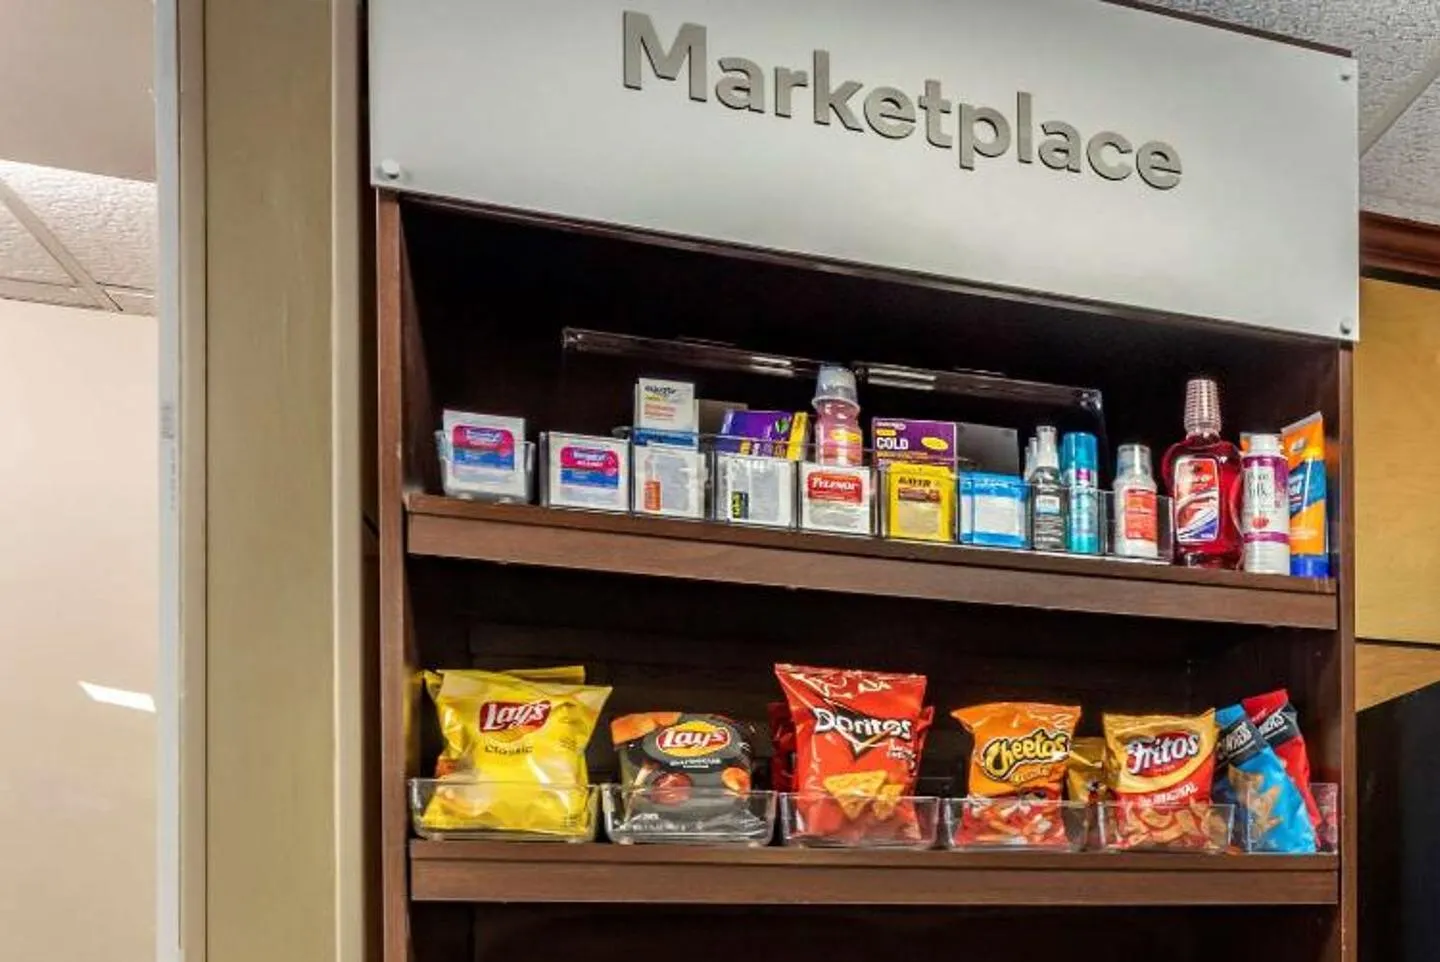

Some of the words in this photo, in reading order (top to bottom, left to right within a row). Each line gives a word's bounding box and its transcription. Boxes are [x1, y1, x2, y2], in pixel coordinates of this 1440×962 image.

[622, 9, 1184, 190] Marketplace
[876, 436, 909, 450] COLD
[812, 707, 913, 741] Doritos
[983, 729, 1069, 779] Cheetos
[1126, 734, 1199, 775] Fritos
